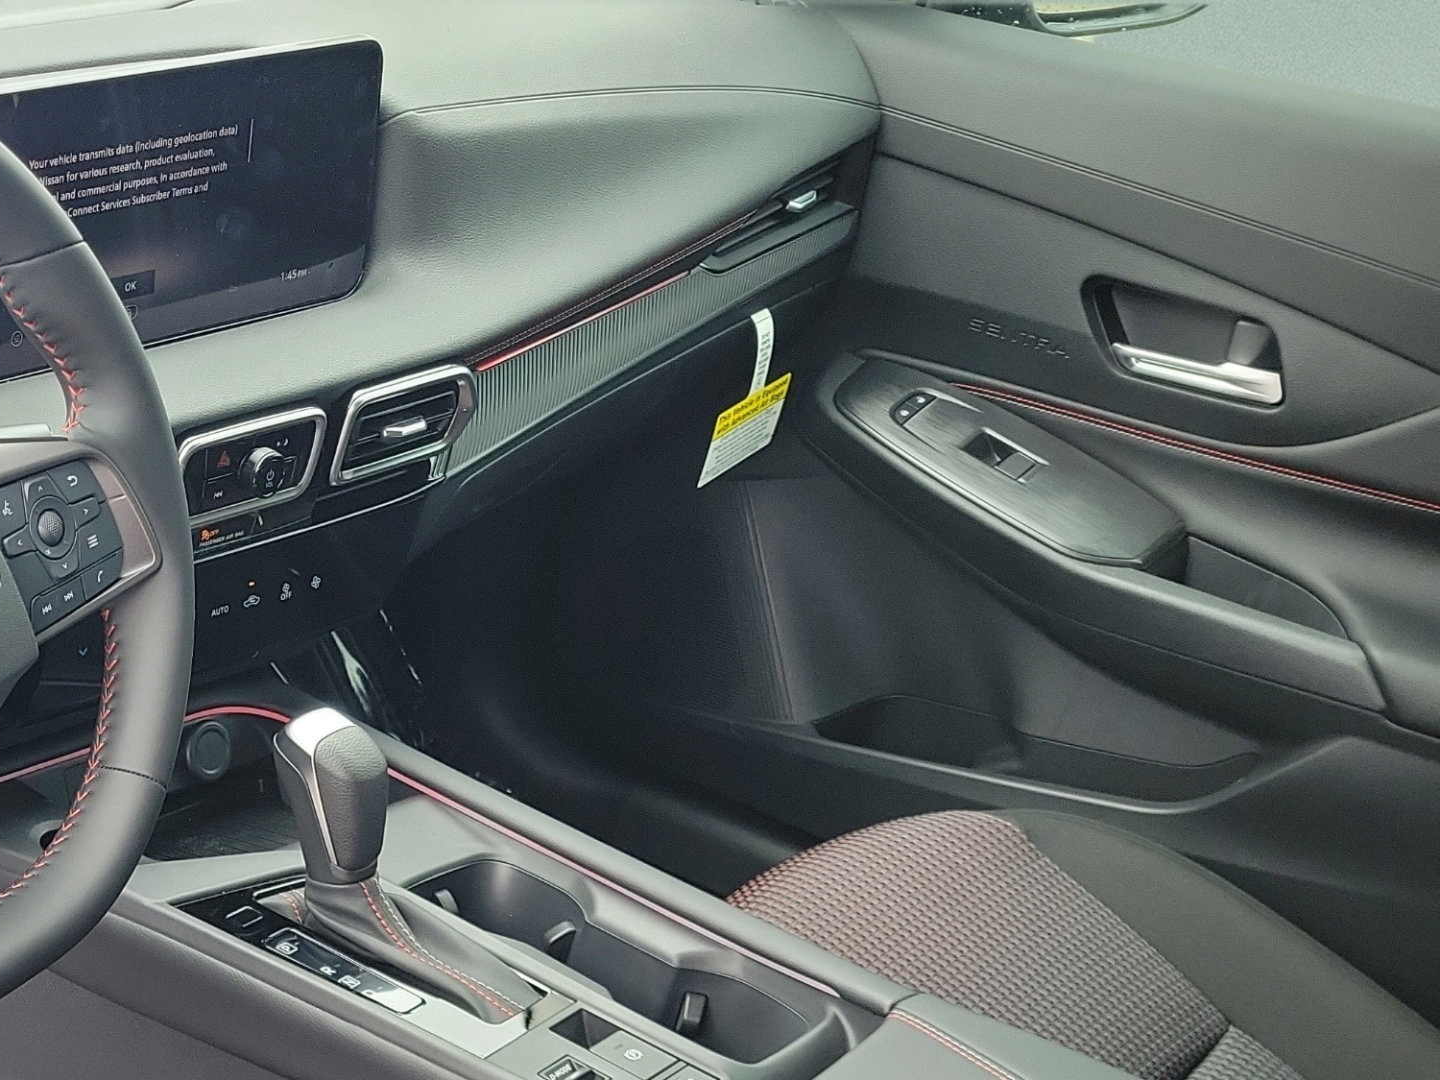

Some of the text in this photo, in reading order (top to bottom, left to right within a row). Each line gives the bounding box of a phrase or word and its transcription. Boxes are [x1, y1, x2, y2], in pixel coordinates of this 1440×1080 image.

[29, 124, 239, 170] Your vehicle transmits data (including geolocation data)
[66, 171, 78, 183] for
[79, 167, 108, 180] various
[108, 159, 143, 174] research,
[144, 154, 174, 170] product
[174, 147, 215, 162] evaluation,
[60, 188, 76, 201] and
[77, 179, 122, 198] commercial
[123, 175, 159, 192] purposes,
[160, 173, 168, 183] in
[168, 166, 210, 181] accordance
[211, 160, 228, 172] with
[100, 198, 131, 211] Services
[131, 190, 171, 206] Subscriber
[172, 186, 193, 198] Terms
[194, 181, 209, 192] and
[124, 281, 137, 293] OK
[280, 590, 292, 601] OFF
[211, 605, 229, 617] AUTO
